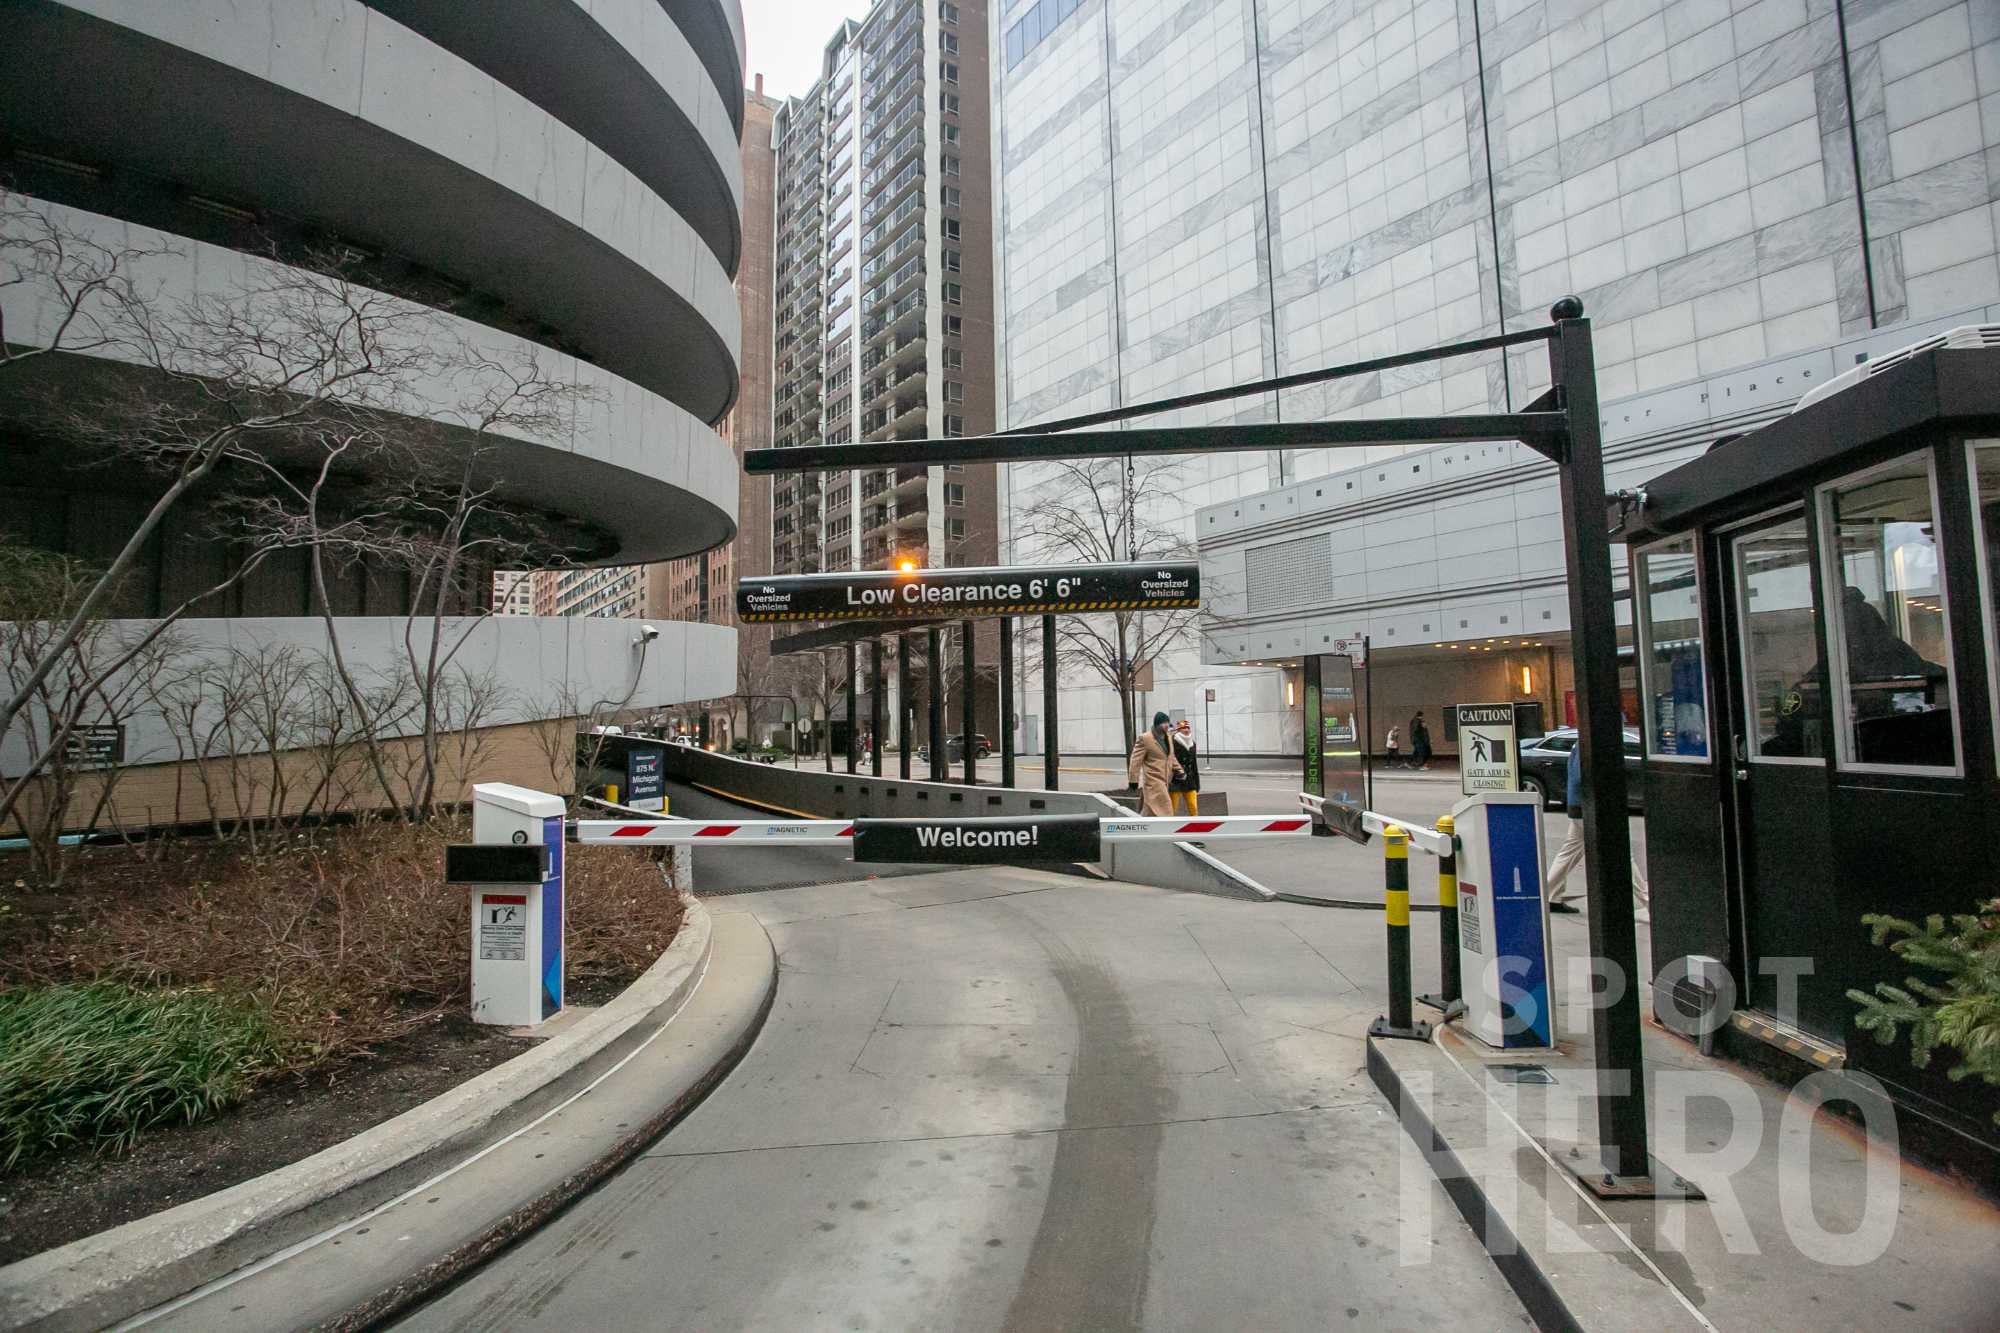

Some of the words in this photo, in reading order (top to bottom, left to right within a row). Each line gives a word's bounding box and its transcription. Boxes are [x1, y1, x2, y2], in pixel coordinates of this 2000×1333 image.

[1700, 369, 1811, 403] Place
[1157, 571, 1172, 579] No
[1141, 580, 1189, 589] Oversized
[762, 585, 776, 594] No
[847, 585, 895, 605] Low
[902, 583, 1022, 604] Clearance
[1029, 578, 1049, 599] 6'
[1056, 577, 1081, 598] 6"
[1145, 589, 1185, 598] Vehicles
[746, 594, 791, 603] Oversized
[750, 603, 789, 612] Vehicles
[1460, 709, 1511, 722] CAUTION!
[632, 775, 659, 784] Michigan
[916, 825, 1039, 848] Welcome!
